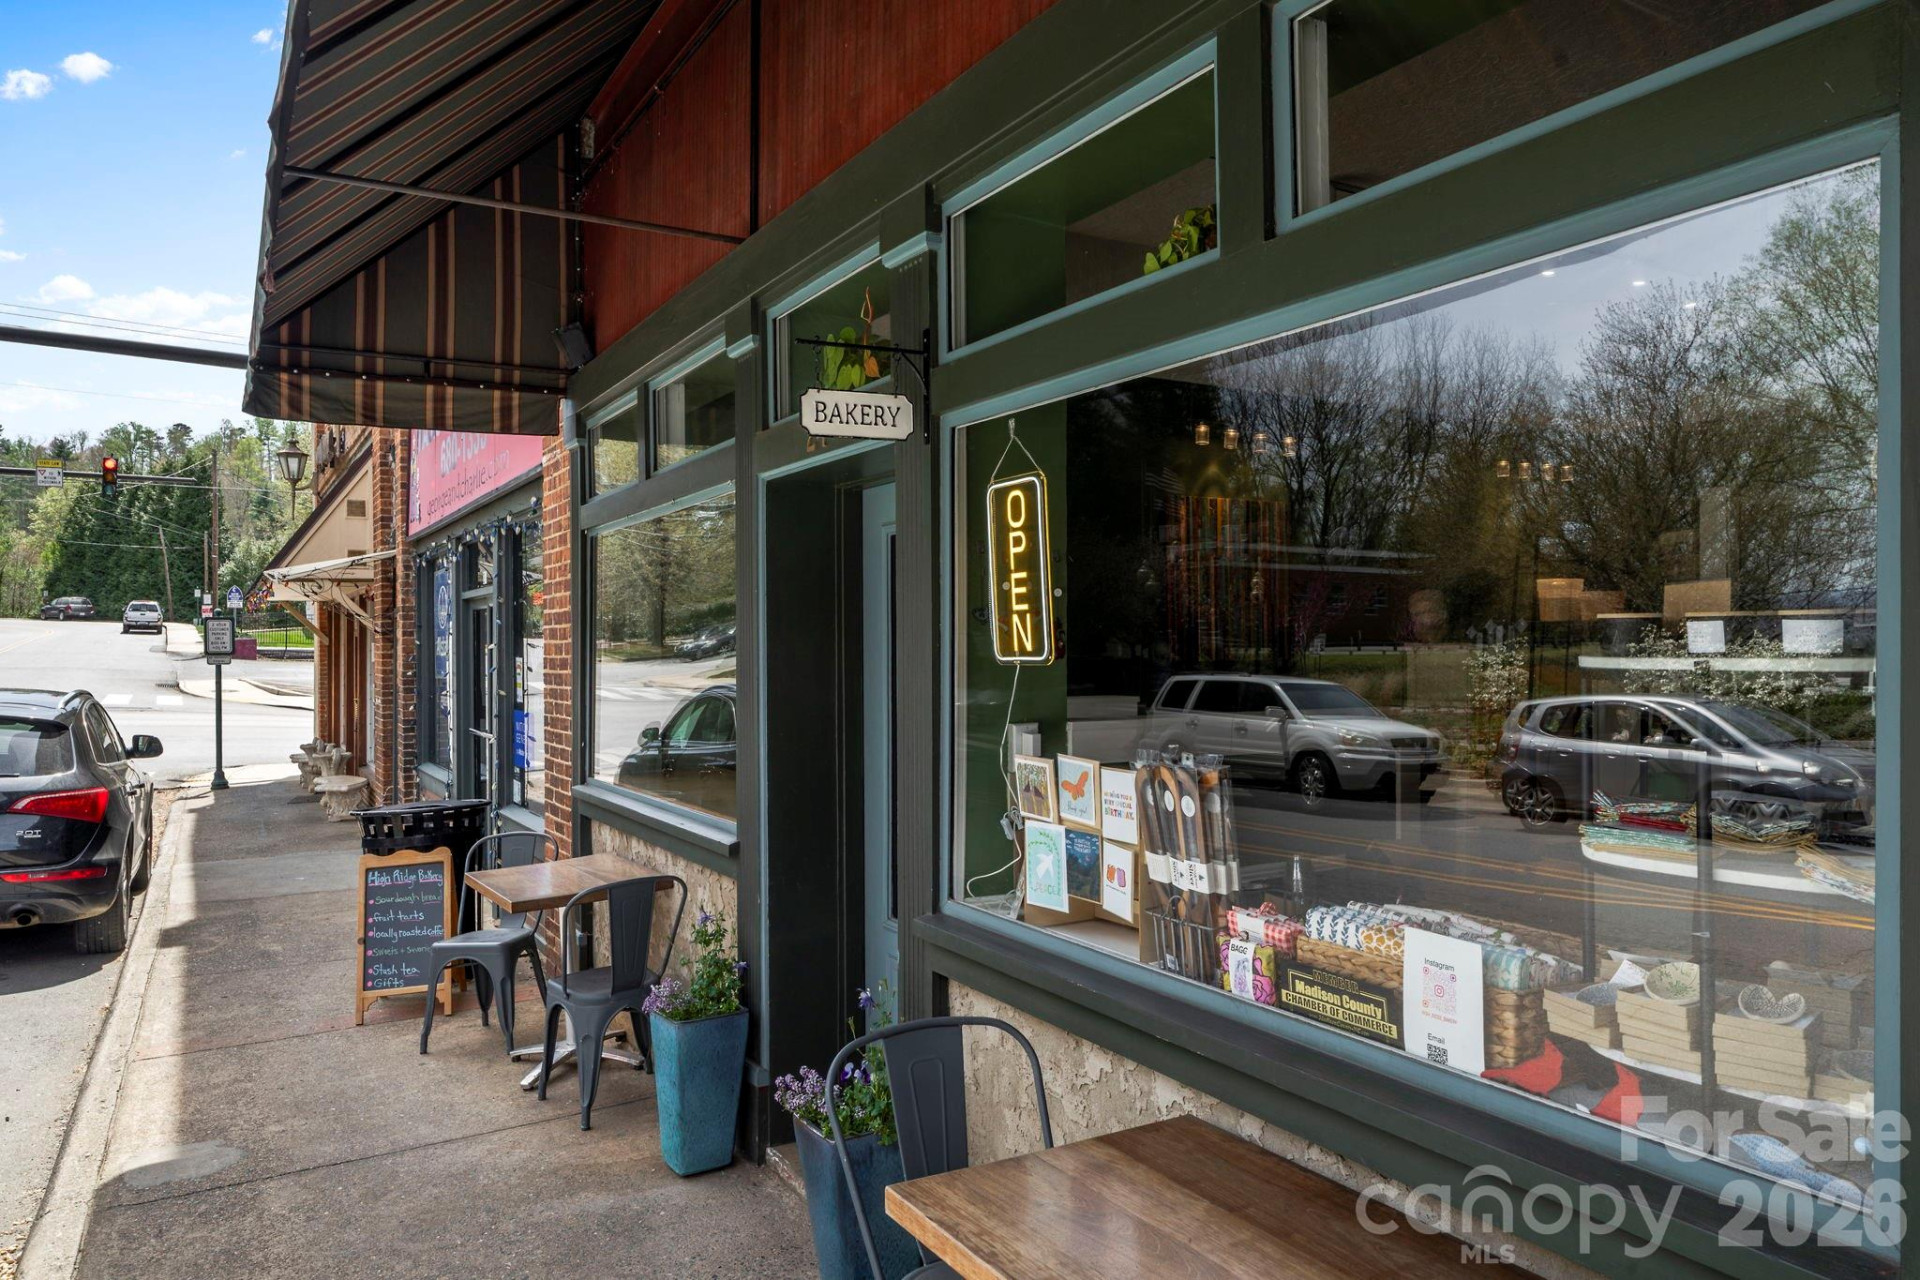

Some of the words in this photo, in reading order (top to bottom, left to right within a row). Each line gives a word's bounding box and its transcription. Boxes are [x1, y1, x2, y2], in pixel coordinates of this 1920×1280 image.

[815, 401, 901, 427] BAKERY
[1007, 489, 1032, 652] OPEN
[368, 870, 391, 887] High
[393, 869, 416, 889] Ridge
[418, 869, 443, 886] Bakery
[397, 910, 424, 921] tarts
[399, 926, 427, 937] roasted
[373, 963, 398, 976] Stash
[400, 962, 420, 975] tea
[1424, 957, 1455, 972] Instagram
[374, 977, 404, 988] Gifts
[1312, 969, 1359, 994] MEMBER
[1295, 979, 1341, 1006] Madison
[1342, 994, 1382, 1019] County
[1285, 992, 1328, 1015] CHAMBER
[1329, 1005, 1341, 1018] OF
[1342, 1010, 1394, 1036] COMMERCE
[1427, 1032, 1446, 1045] Email
